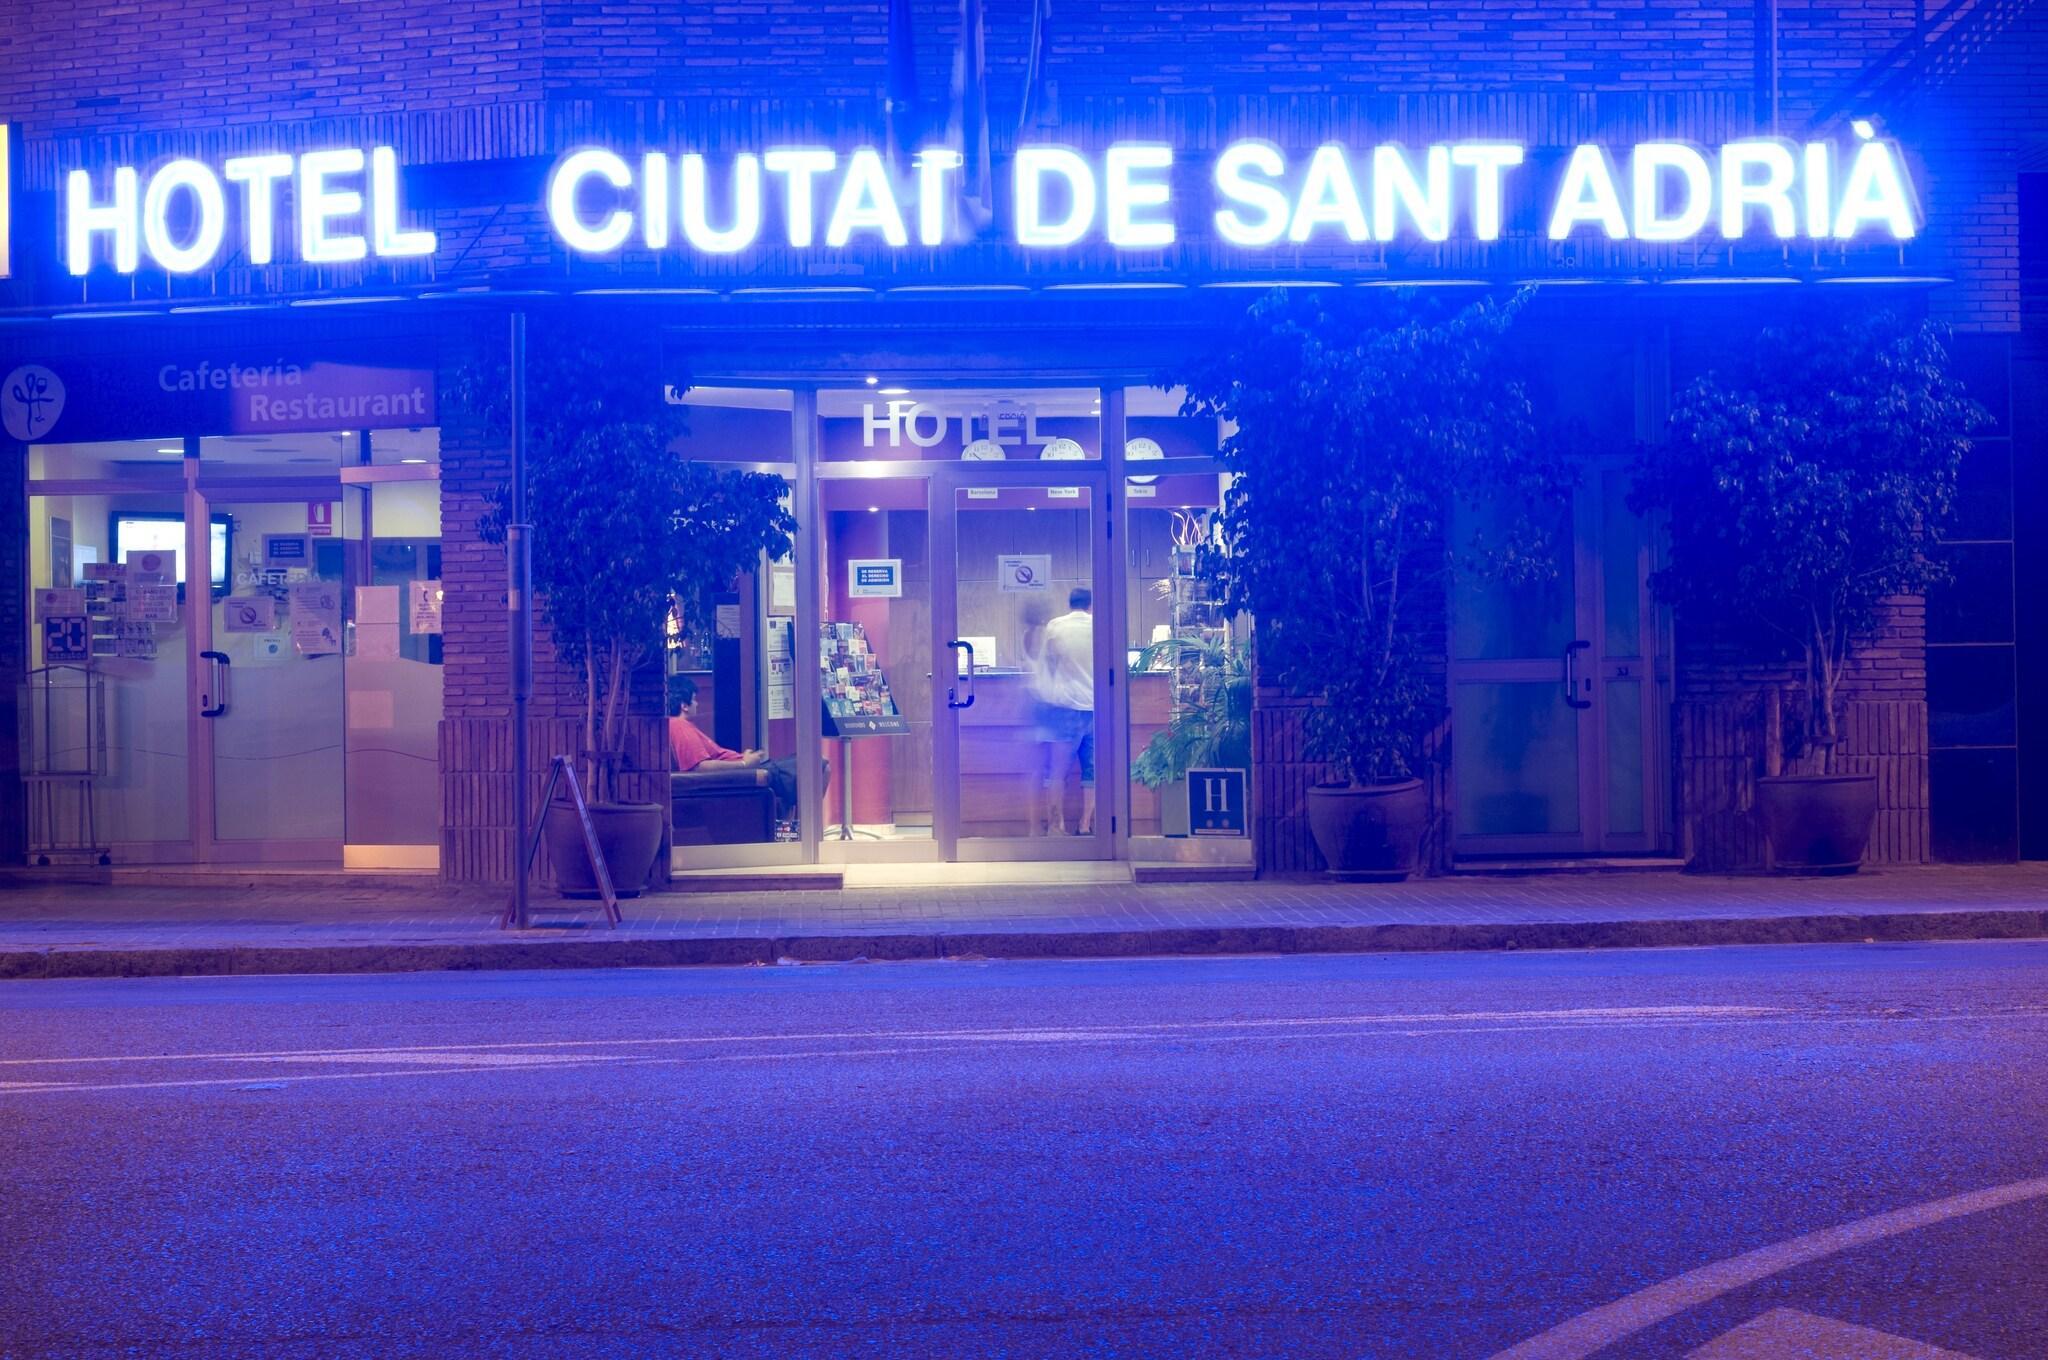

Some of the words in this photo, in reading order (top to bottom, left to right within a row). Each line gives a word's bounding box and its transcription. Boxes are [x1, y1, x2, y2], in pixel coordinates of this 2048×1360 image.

[67, 145, 437, 276] HOTEL
[548, 145, 963, 252] CIUTAT
[1014, 143, 1175, 248] DE
[1214, 138, 1525, 247] SANT
[1548, 119, 1917, 242] ADRIÀ
[158, 358, 302, 392] Cafetería
[249, 387, 426, 422] Restaurant
[863, 402, 1057, 448] HOTEL
[1203, 777, 1231, 812] H
